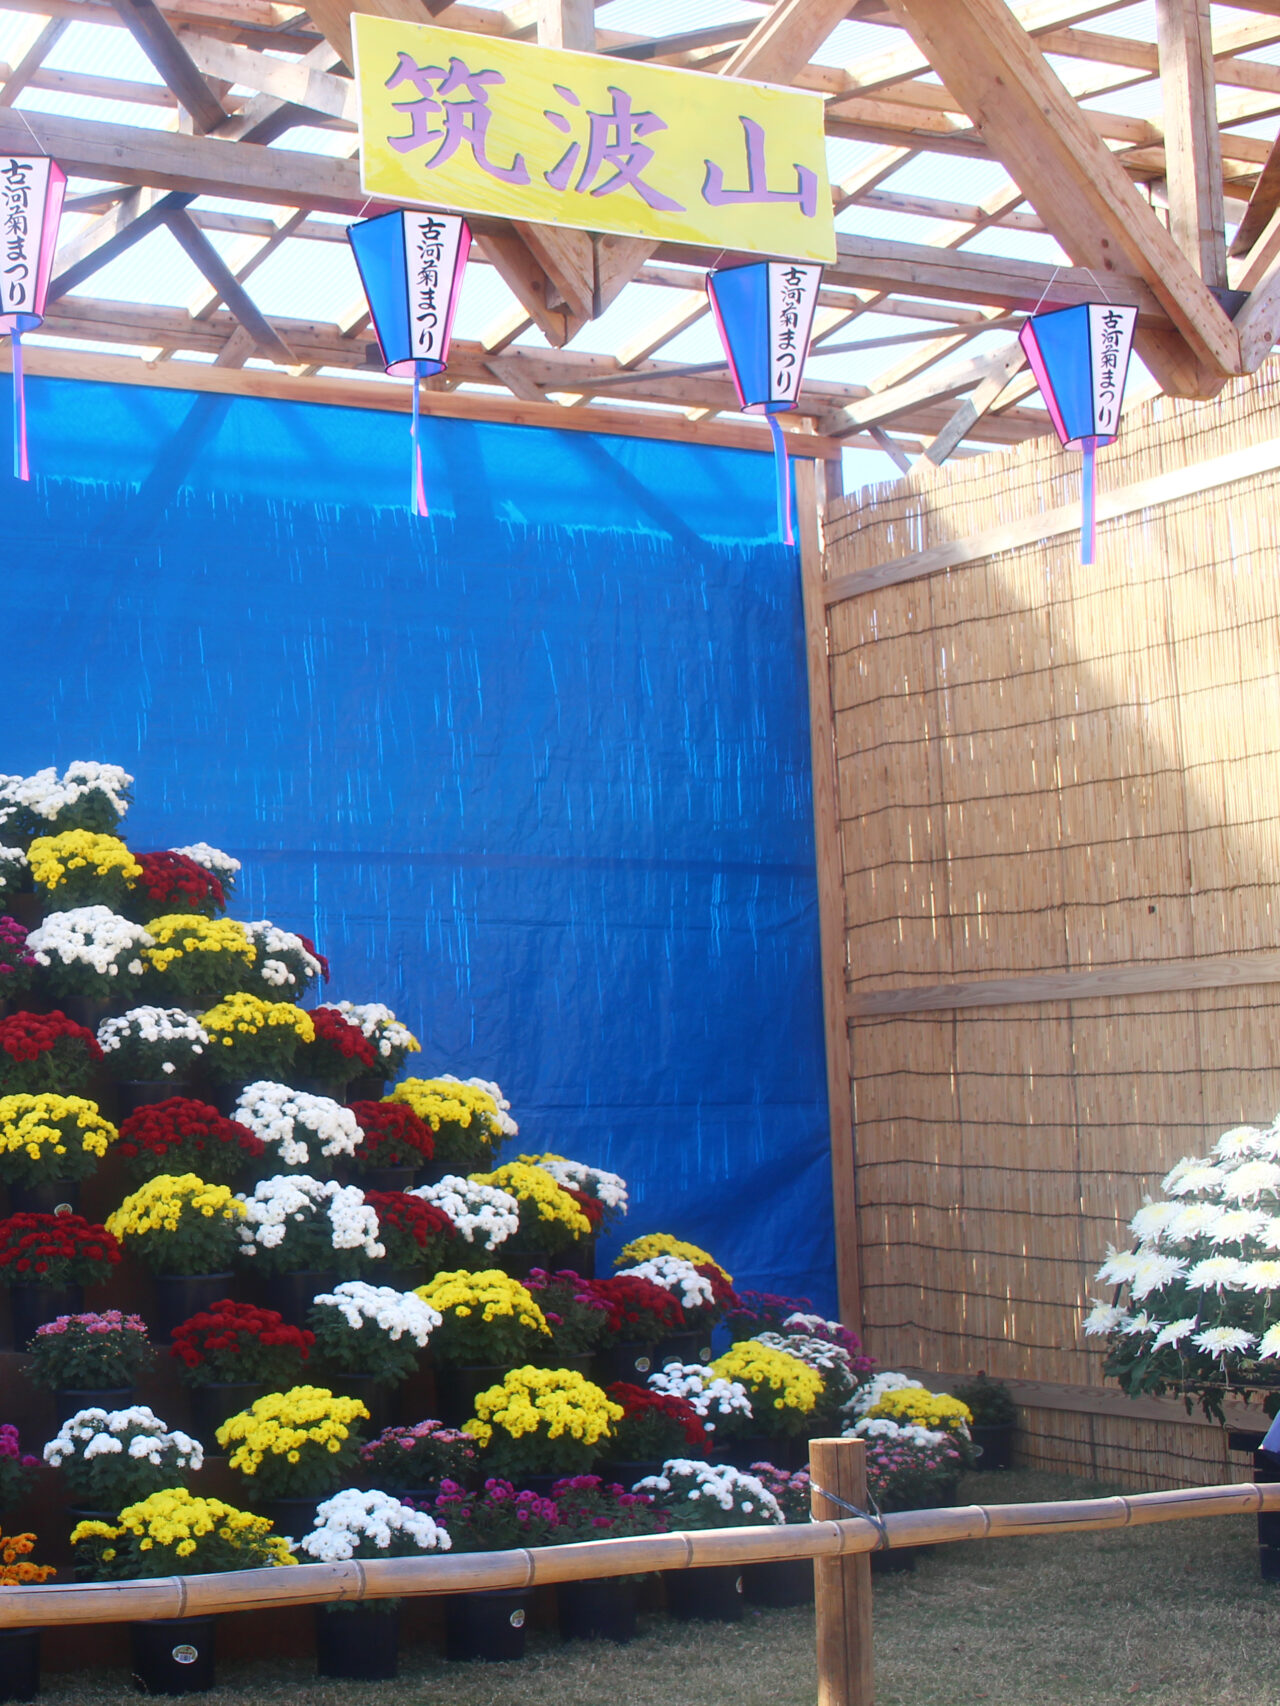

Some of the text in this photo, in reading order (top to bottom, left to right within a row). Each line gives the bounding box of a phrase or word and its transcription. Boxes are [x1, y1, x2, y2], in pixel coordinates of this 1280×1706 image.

[384, 50, 819, 219] 筑波山
[0, 158, 34, 306] 古河菊まつり
[415, 216, 447, 354] 古河菊まつり
[776, 266, 808, 395] 古河菊まつり
[1098, 309, 1124, 428] 古河菊まつり
